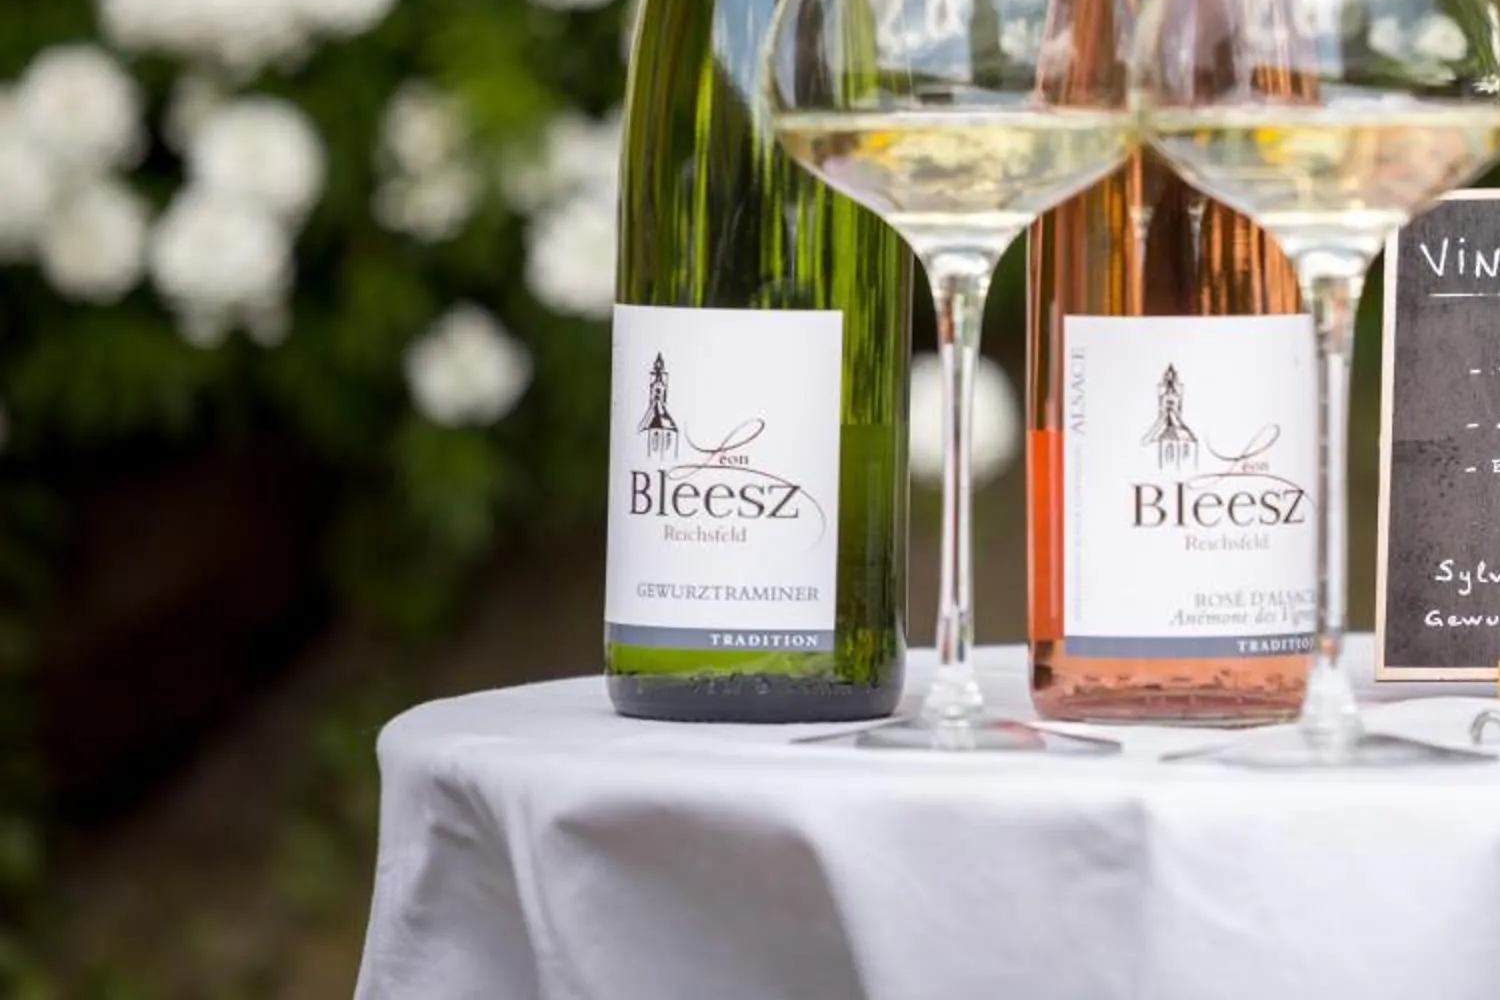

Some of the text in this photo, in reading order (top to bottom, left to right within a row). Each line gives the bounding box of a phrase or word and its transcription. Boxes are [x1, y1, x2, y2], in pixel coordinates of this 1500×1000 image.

[629, 468, 802, 519] Bleesz
[1131, 482, 1307, 528] Bleesz
[663, 523, 748, 544] Reichsfeld
[636, 582, 820, 602] GEWURZTRAMINER
[710, 633, 818, 647] TRADITION
